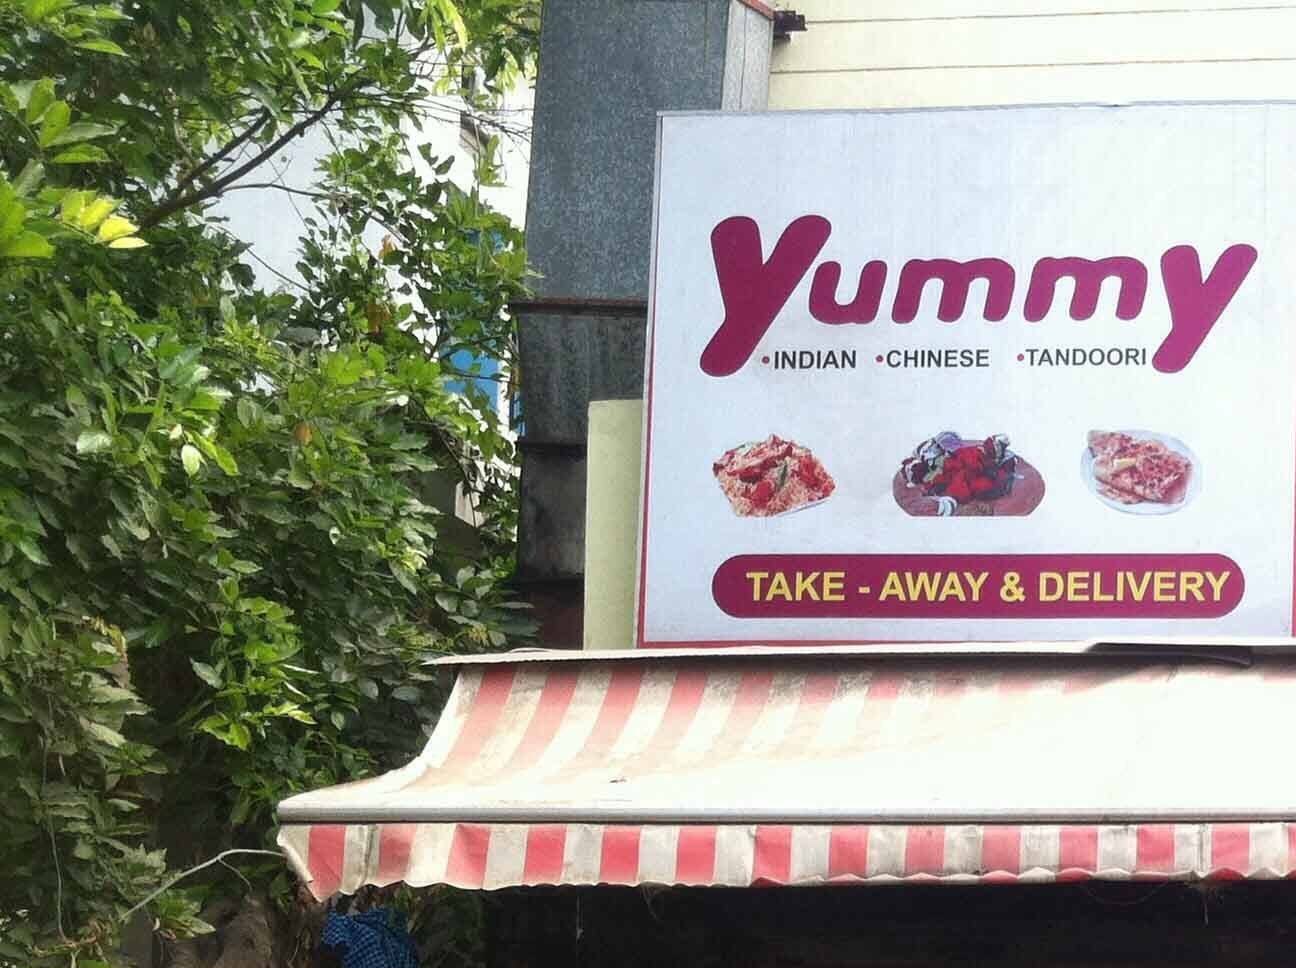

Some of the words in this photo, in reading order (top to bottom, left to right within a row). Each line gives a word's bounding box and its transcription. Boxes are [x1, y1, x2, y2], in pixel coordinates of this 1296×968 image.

[699, 214, 1258, 378] Yummy
[774, 350, 857, 370] INDIAN
[886, 349, 989, 368] CHINESE
[1025, 348, 1147, 366] TANDOORI
[745, 571, 846, 601] TAKE
[878, 571, 989, 602] AWAY
[1000, 571, 1026, 603] &
[1039, 570, 1231, 602] DELIVERY
